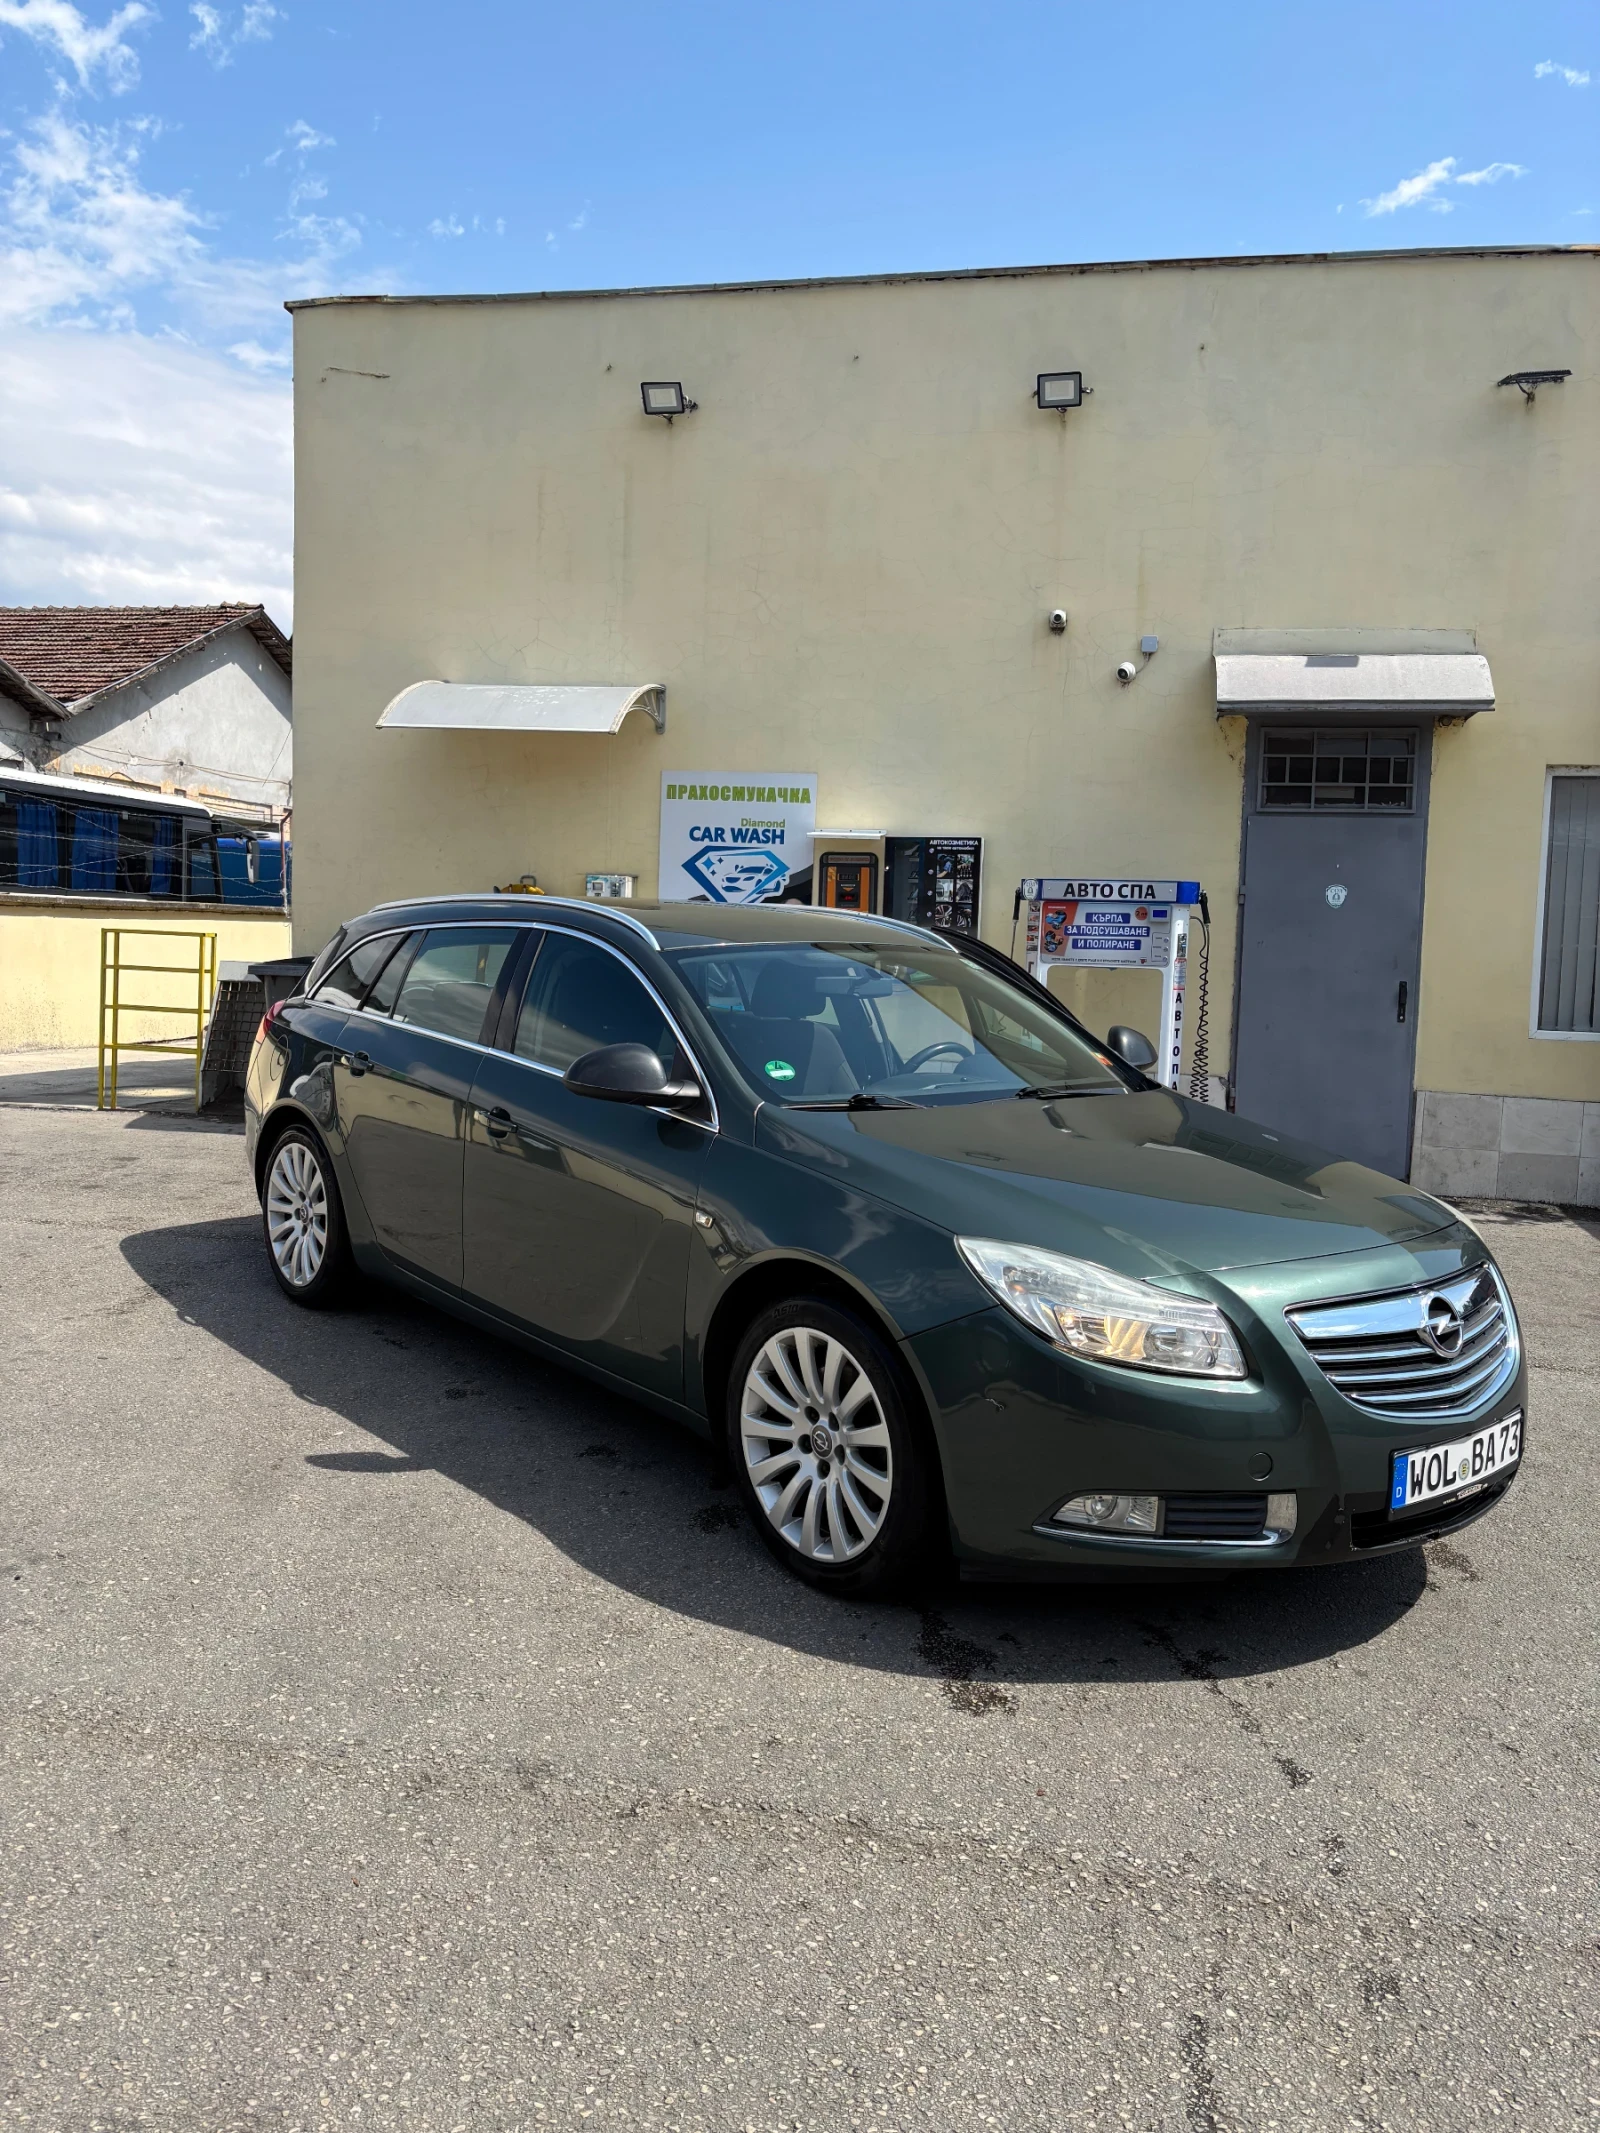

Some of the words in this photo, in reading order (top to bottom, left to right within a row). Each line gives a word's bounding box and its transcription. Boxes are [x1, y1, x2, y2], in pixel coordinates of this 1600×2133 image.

[666, 784, 811, 804] ПРАХОСМУКАЧКА
[741, 818, 786, 829] Diamond
[689, 826, 726, 842] CAR
[730, 828, 785, 845] WASH
[1063, 882, 1114, 899] АВТО
[1117, 883, 1157, 899] СПА
[1092, 914, 1123, 923] КЪРПА
[1066, 925, 1079, 934] ЗА
[1080, 926, 1148, 936] ПОДСУШАВАНЕ
[1077, 939, 1085, 948] И
[1086, 940, 1135, 949] ПОЛИРАНЕ
[1409, 1449, 1457, 1498] WOL
[1471, 1432, 1495, 1477] BA
[1499, 1419, 1520, 1463] 73
[1396, 1486, 1402, 1498] D
